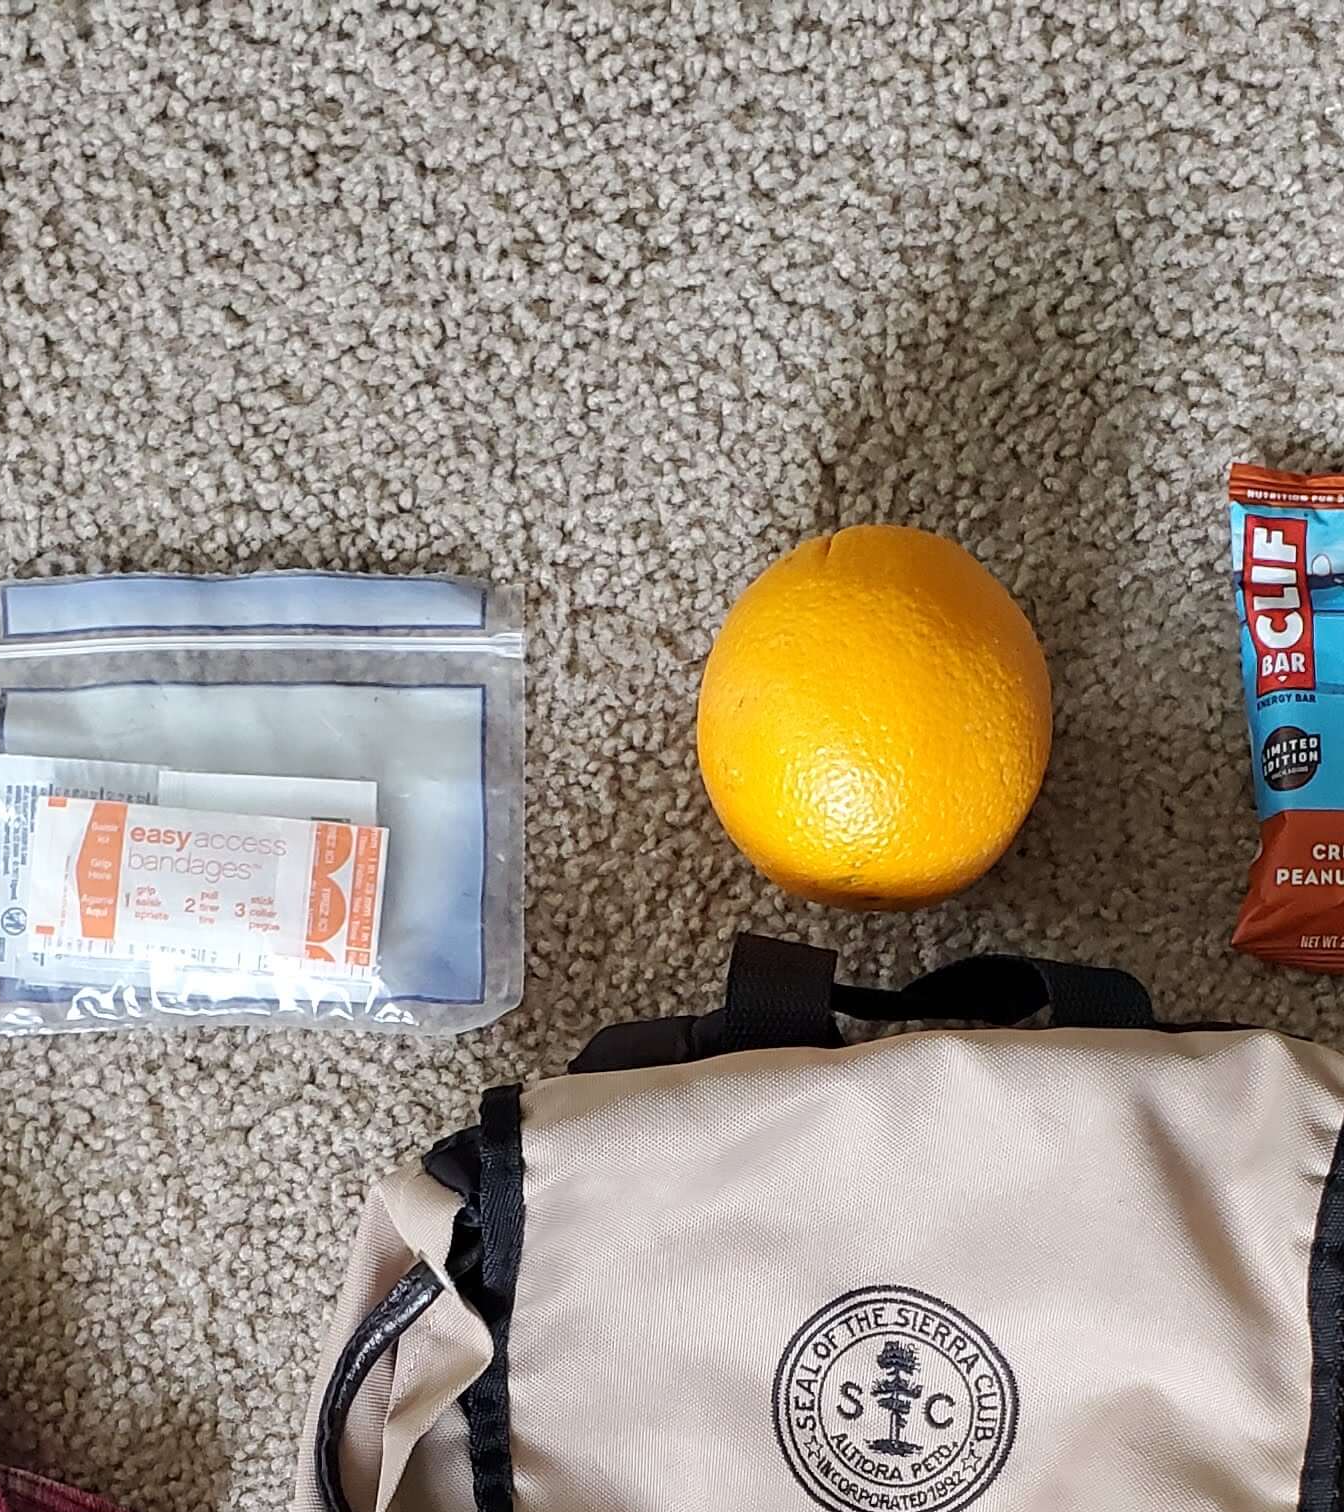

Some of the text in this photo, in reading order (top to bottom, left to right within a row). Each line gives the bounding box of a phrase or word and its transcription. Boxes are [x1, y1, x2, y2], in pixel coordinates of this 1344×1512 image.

[1252, 527, 1304, 649] CLIF
[1261, 652, 1306, 677] BAR
[1295, 694, 1317, 703] BAR
[130, 826, 288, 857] easy access
[184, 898, 196, 913] 2
[234, 902, 246, 917] 3
[1300, 935, 1319, 949] NET
[1322, 935, 1338, 948] WT
[794, 1364, 822, 1432] SEAL
[813, 1331, 839, 1361] OF
[841, 1306, 890, 1338] THE
[894, 1306, 981, 1374] SIERRA
[836, 1380, 956, 1430] S C
[815, 1457, 927, 1510] INCORPORATED
